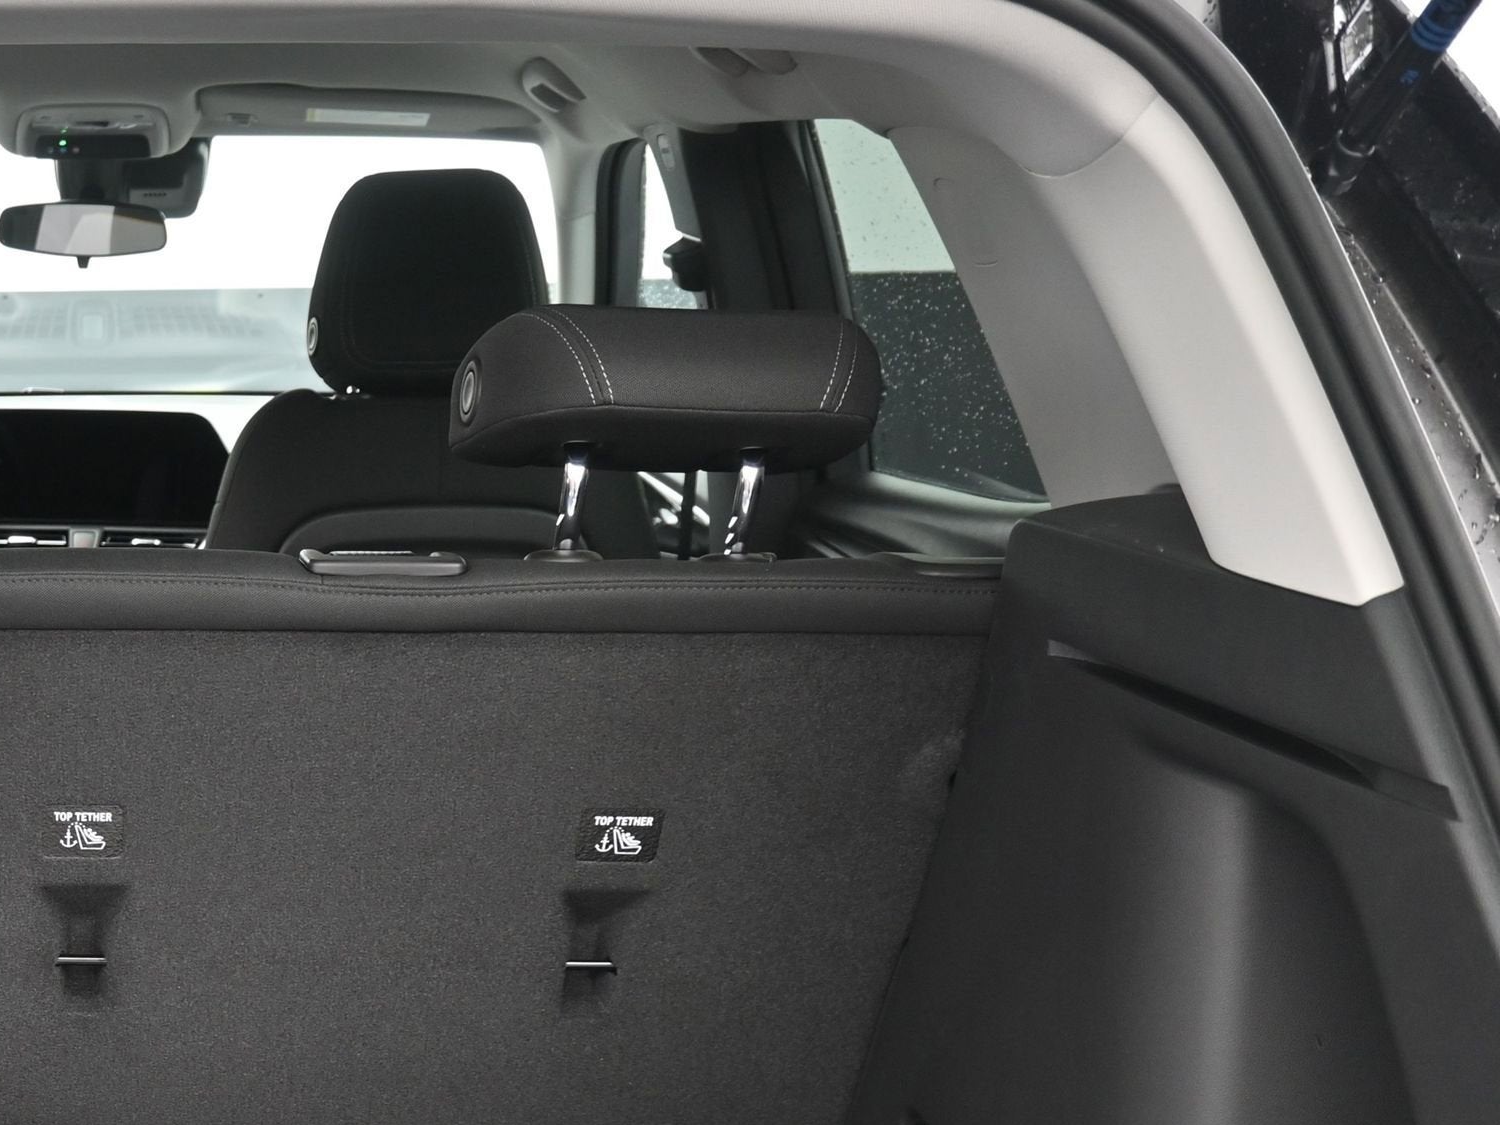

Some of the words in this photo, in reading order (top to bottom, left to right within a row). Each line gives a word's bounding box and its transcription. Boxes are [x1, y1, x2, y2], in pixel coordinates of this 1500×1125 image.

[54, 811, 72, 822] TOP
[75, 812, 112, 822] TETHER
[594, 816, 614, 826] TOP
[615, 816, 654, 826] TETHER
